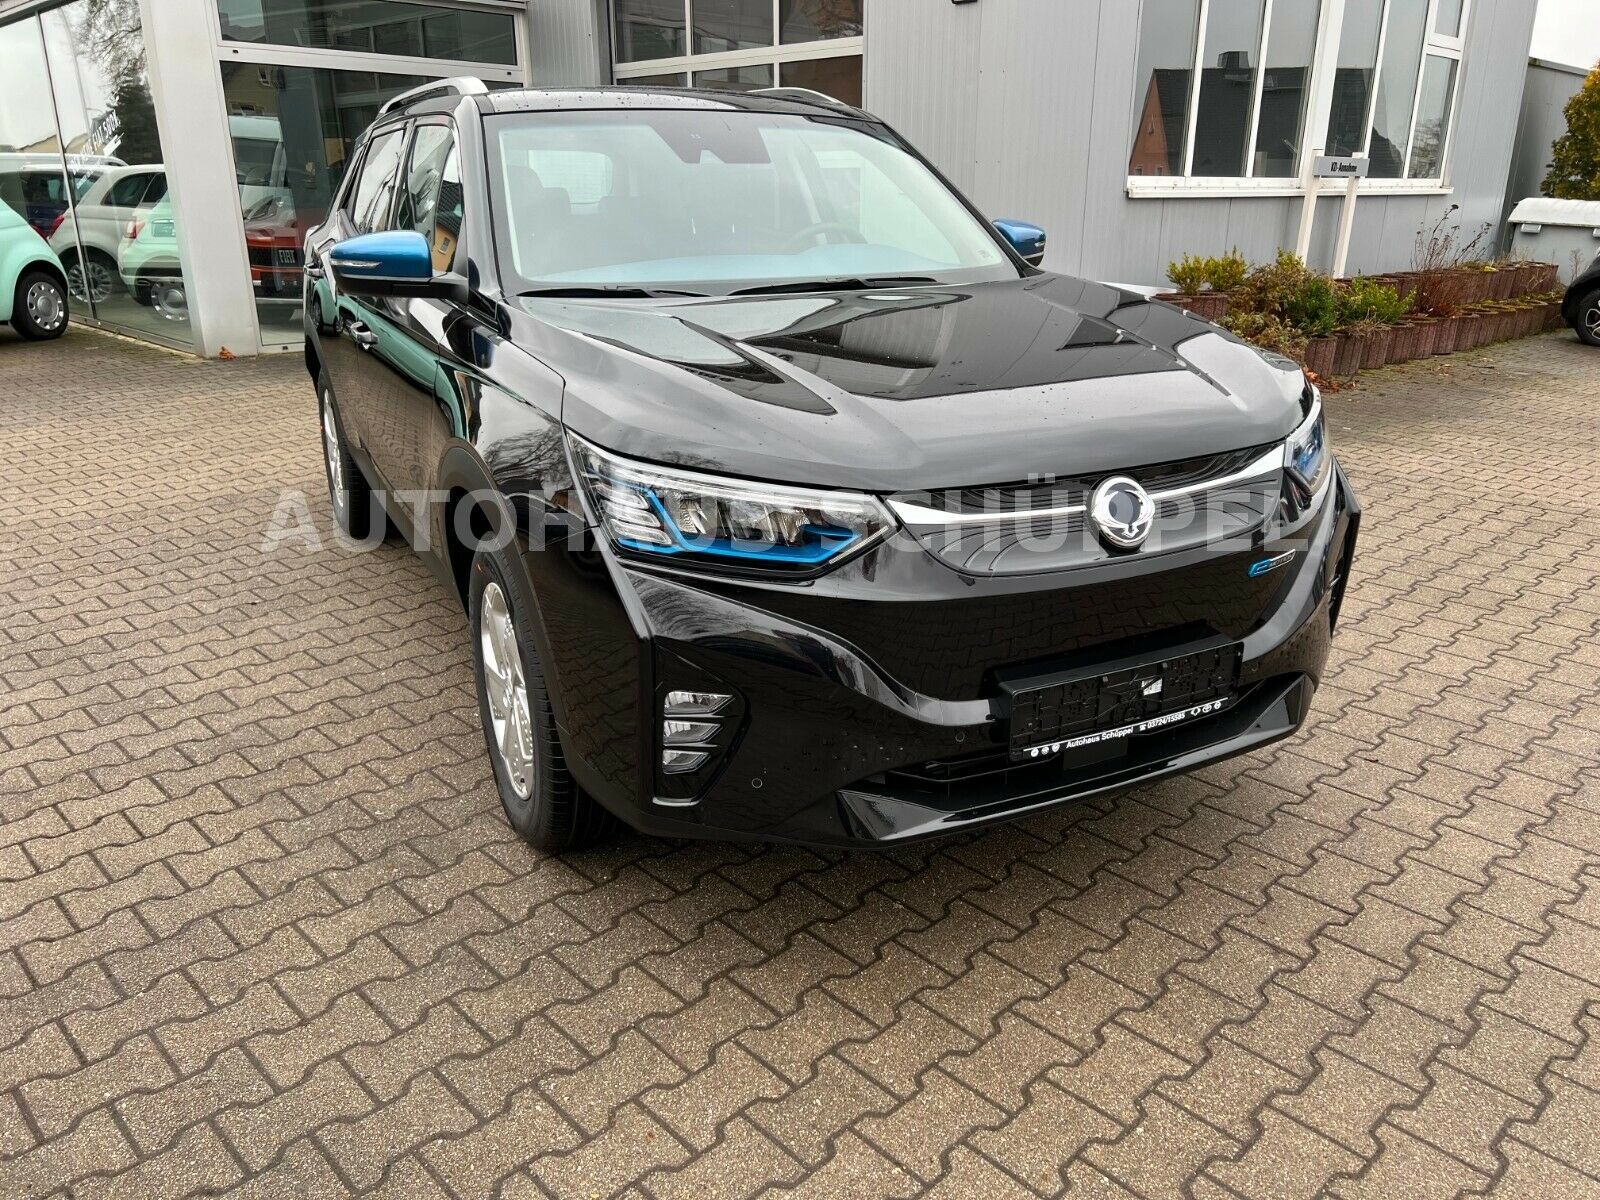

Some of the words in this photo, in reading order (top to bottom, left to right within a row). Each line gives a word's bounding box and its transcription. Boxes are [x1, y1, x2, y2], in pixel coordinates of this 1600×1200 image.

[279, 250, 295, 263] FIAT
[1066, 736, 1100, 748] Autohaus
[1101, 727, 1134, 741] Schüppel
